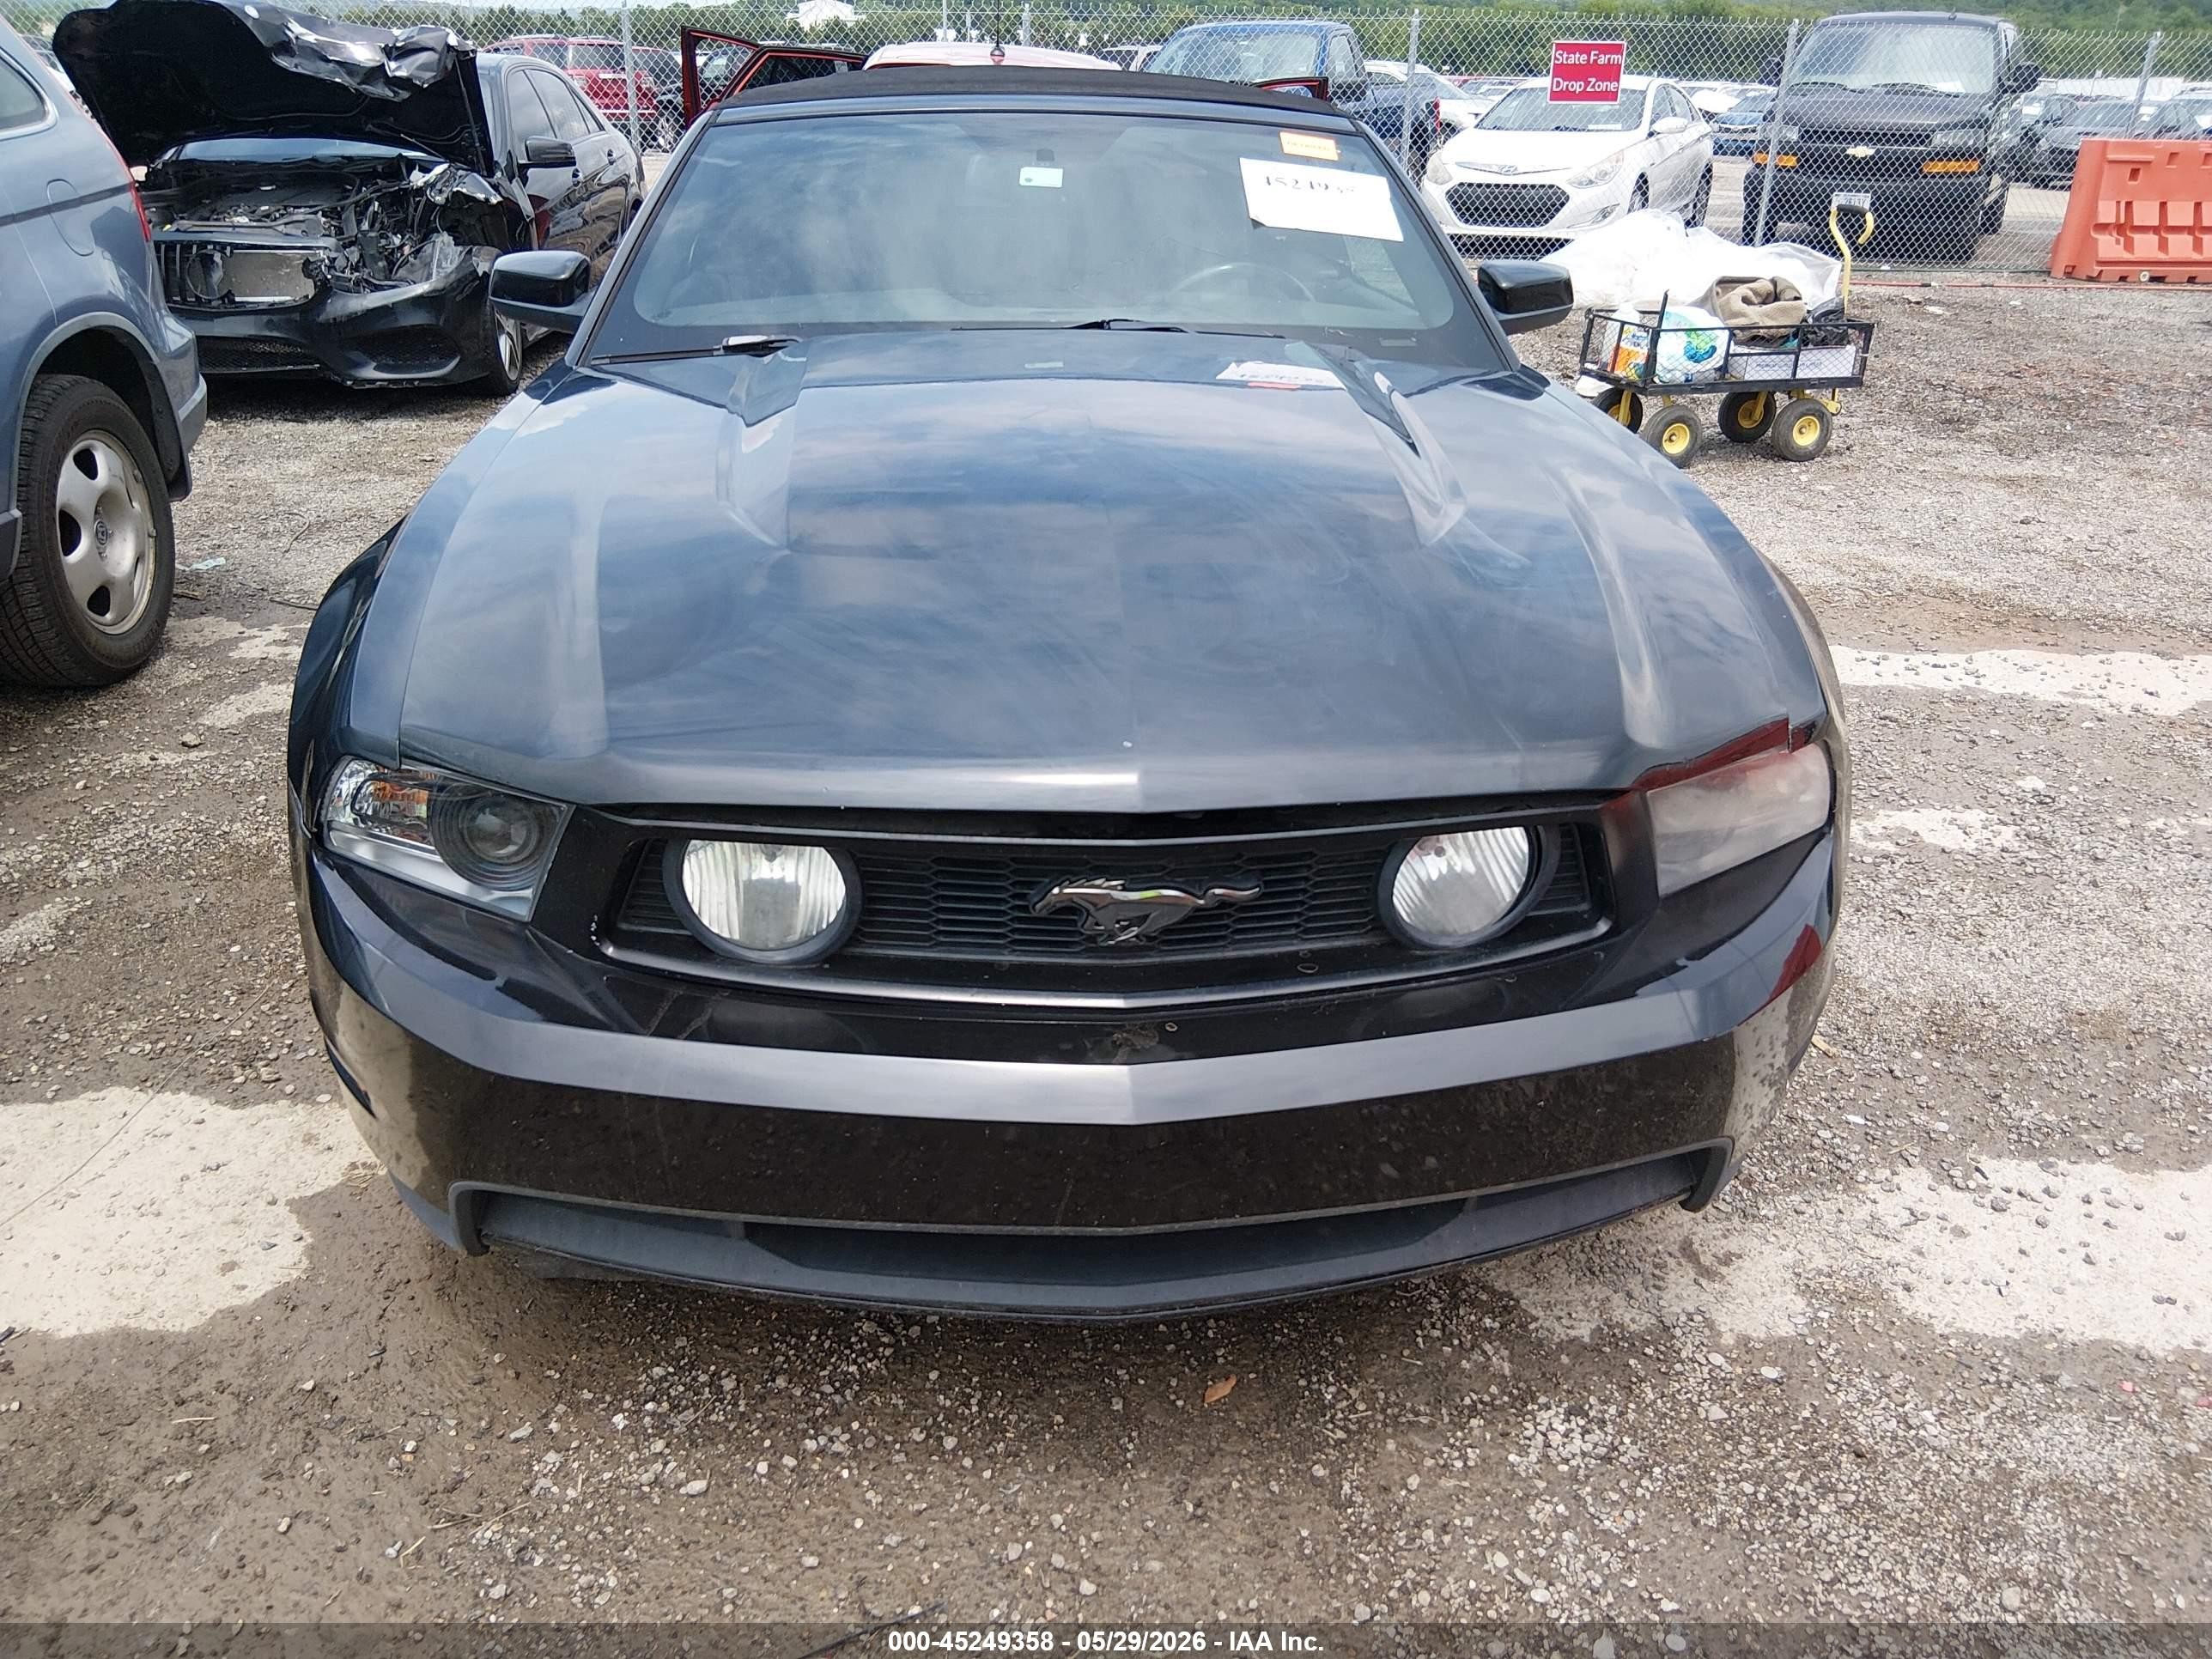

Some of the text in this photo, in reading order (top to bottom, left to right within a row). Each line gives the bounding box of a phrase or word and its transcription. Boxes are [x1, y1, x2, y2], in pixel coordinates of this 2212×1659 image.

[1554, 50, 1622, 64] State Farm
[1553, 77, 1618, 94] Drop Zone
